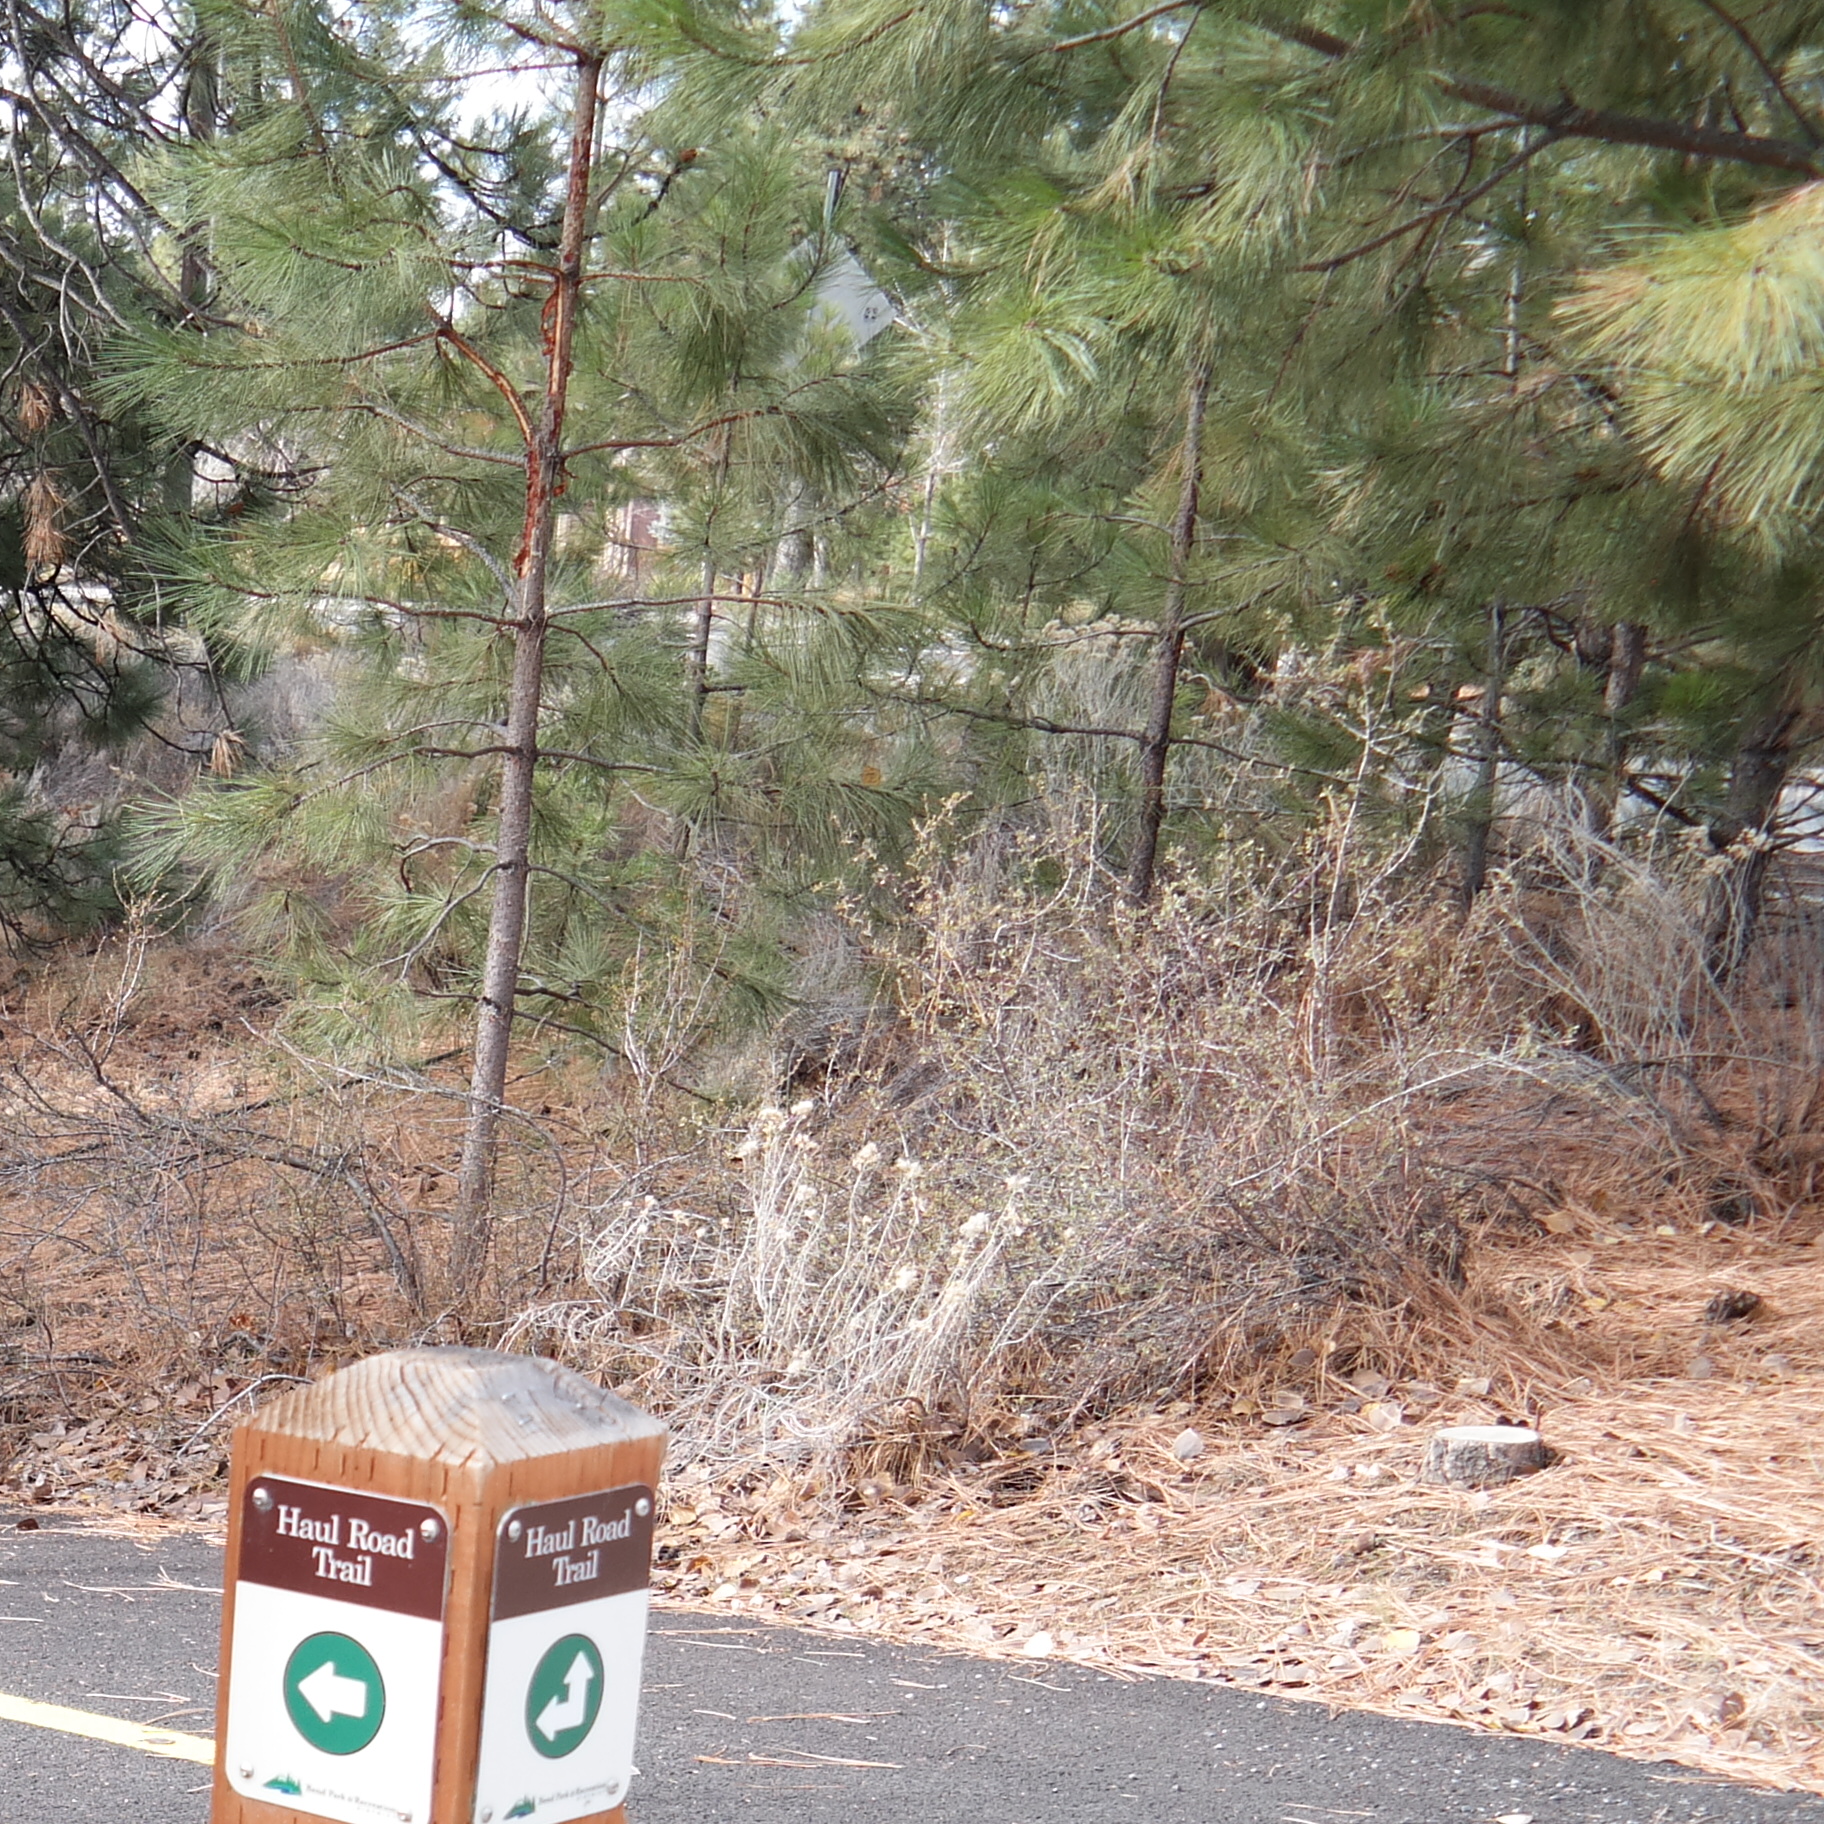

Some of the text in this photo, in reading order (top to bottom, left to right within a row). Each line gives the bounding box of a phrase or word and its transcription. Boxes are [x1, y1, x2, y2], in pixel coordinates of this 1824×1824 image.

[275, 1504, 415, 1559] Haul Road
[524, 1508, 632, 1558] Haul Road
[312, 1545, 373, 1587] Trail
[552, 1549, 599, 1587] Trail
